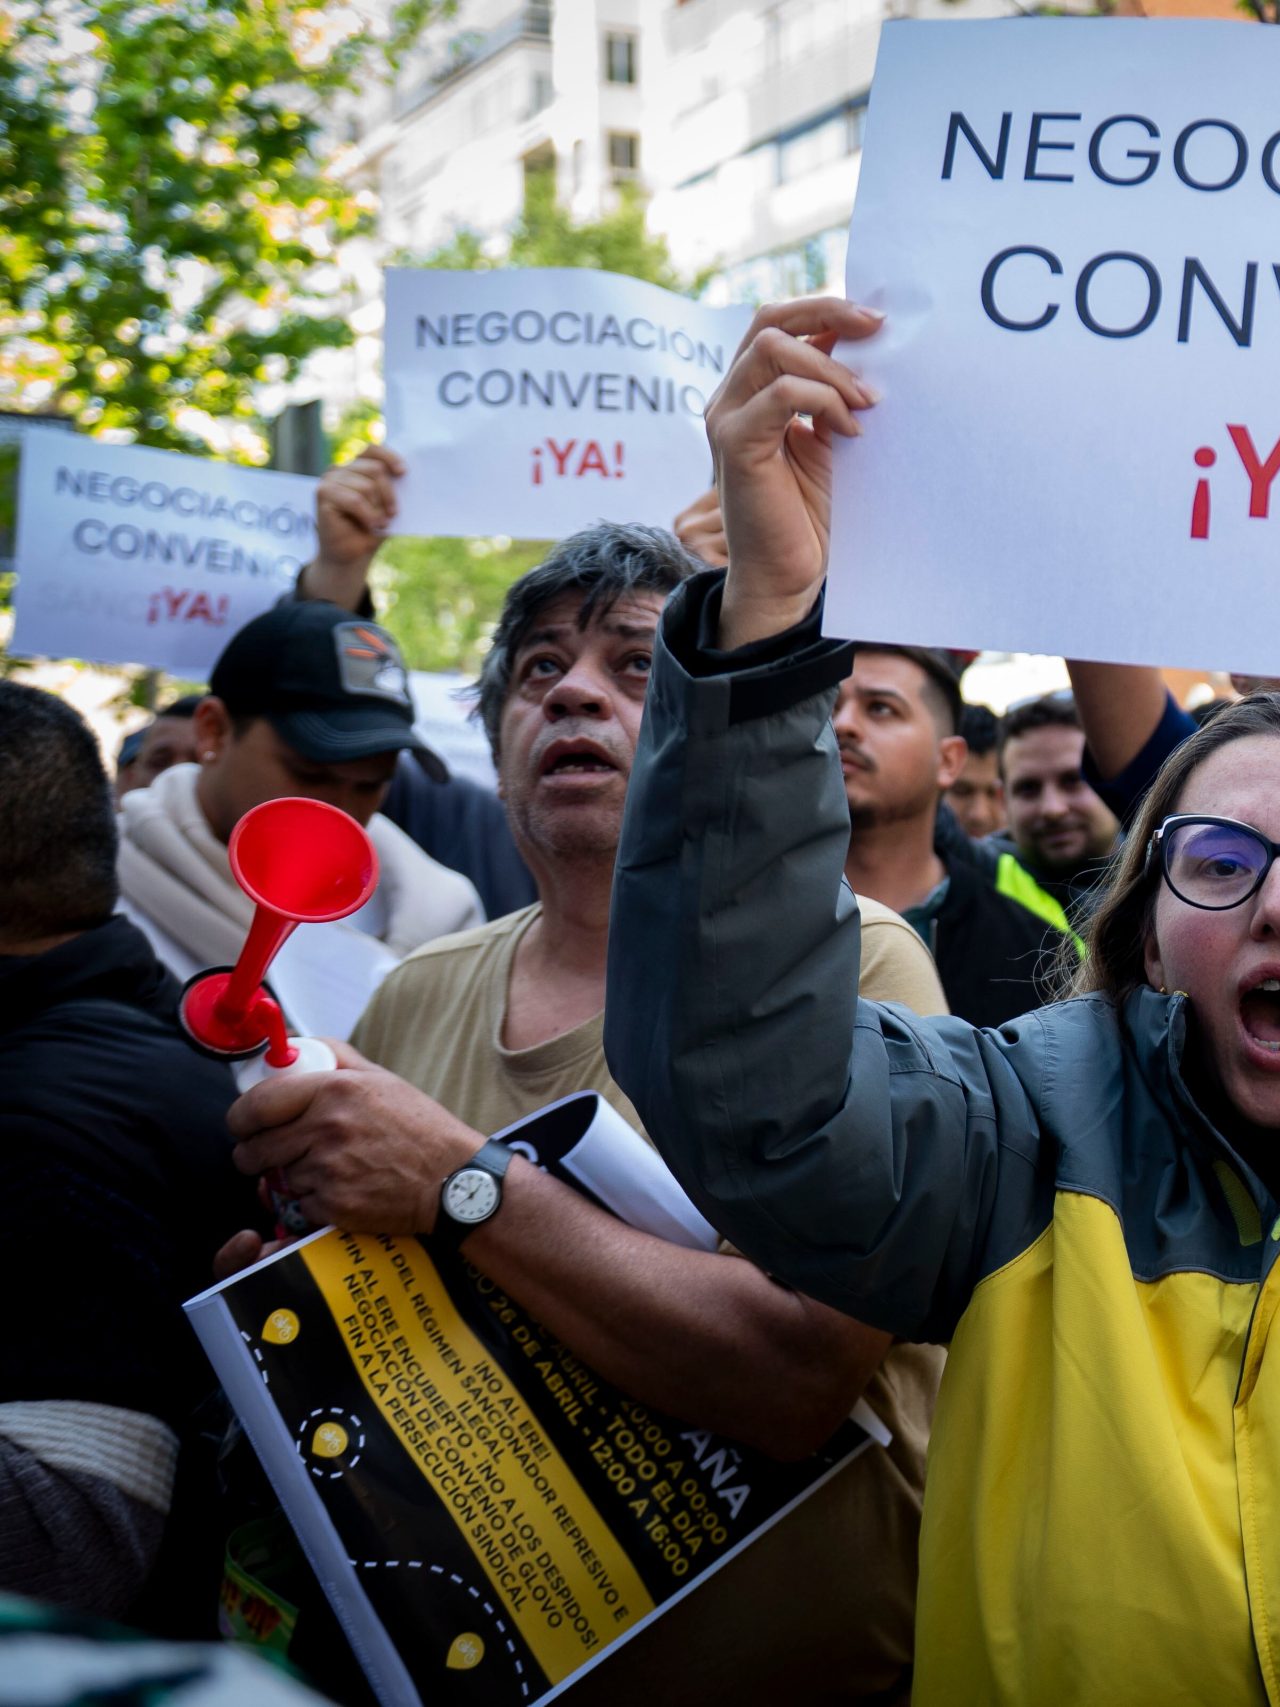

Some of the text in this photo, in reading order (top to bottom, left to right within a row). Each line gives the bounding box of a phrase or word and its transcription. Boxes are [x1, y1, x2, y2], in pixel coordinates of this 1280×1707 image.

[415, 309, 724, 373] NEGOCIACIÓN
[438, 369, 706, 418] CONVENIO
[55, 465, 316, 540] NEGOCIACIÓN
[531, 438, 626, 486] ¡YA!
[72, 518, 301, 581] CONVENIO
[147, 585, 229, 626] ¡YA!
[339, 1232, 365, 1264] FIN
[359, 1269, 379, 1294] AL
[374, 1295, 399, 1335] ERE
[392, 1335, 473, 1448] ENCUBIERTO
[476, 1459, 505, 1494] ¡NO
[501, 1498, 516, 1514] A
[511, 1512, 542, 1552] LOS
[536, 1552, 599, 1650] DESPIDOS!
[343, 1274, 563, 1628] NEGOCIACIÓN DE CONVENIO DE GLOVO
[376, 1232, 629, 1622] IN DEL RÉGIMEN SANCIONADOR REPRESIVO E
[457, 1400, 506, 1464] ILEGAL
[473, 1360, 551, 1463] ¡NO AL ERE!
[511, 1324, 542, 1359] DE
[533, 1360, 584, 1427] ABRIL
[588, 1435, 637, 1496] 12:00
[627, 1497, 650, 1519] A
[645, 1513, 690, 1577] 16:00
[343, 1314, 528, 1613] FIN A LA PERSECUCIÓN SINDICAL
[606, 1413, 658, 1481] TODO
[650, 1480, 677, 1514] EL
[671, 1509, 703, 1557] DÍA
[664, 1459, 685, 1480] A
[679, 1478, 728, 1545] 00:00
[678, 1429, 752, 1520] AÑA
